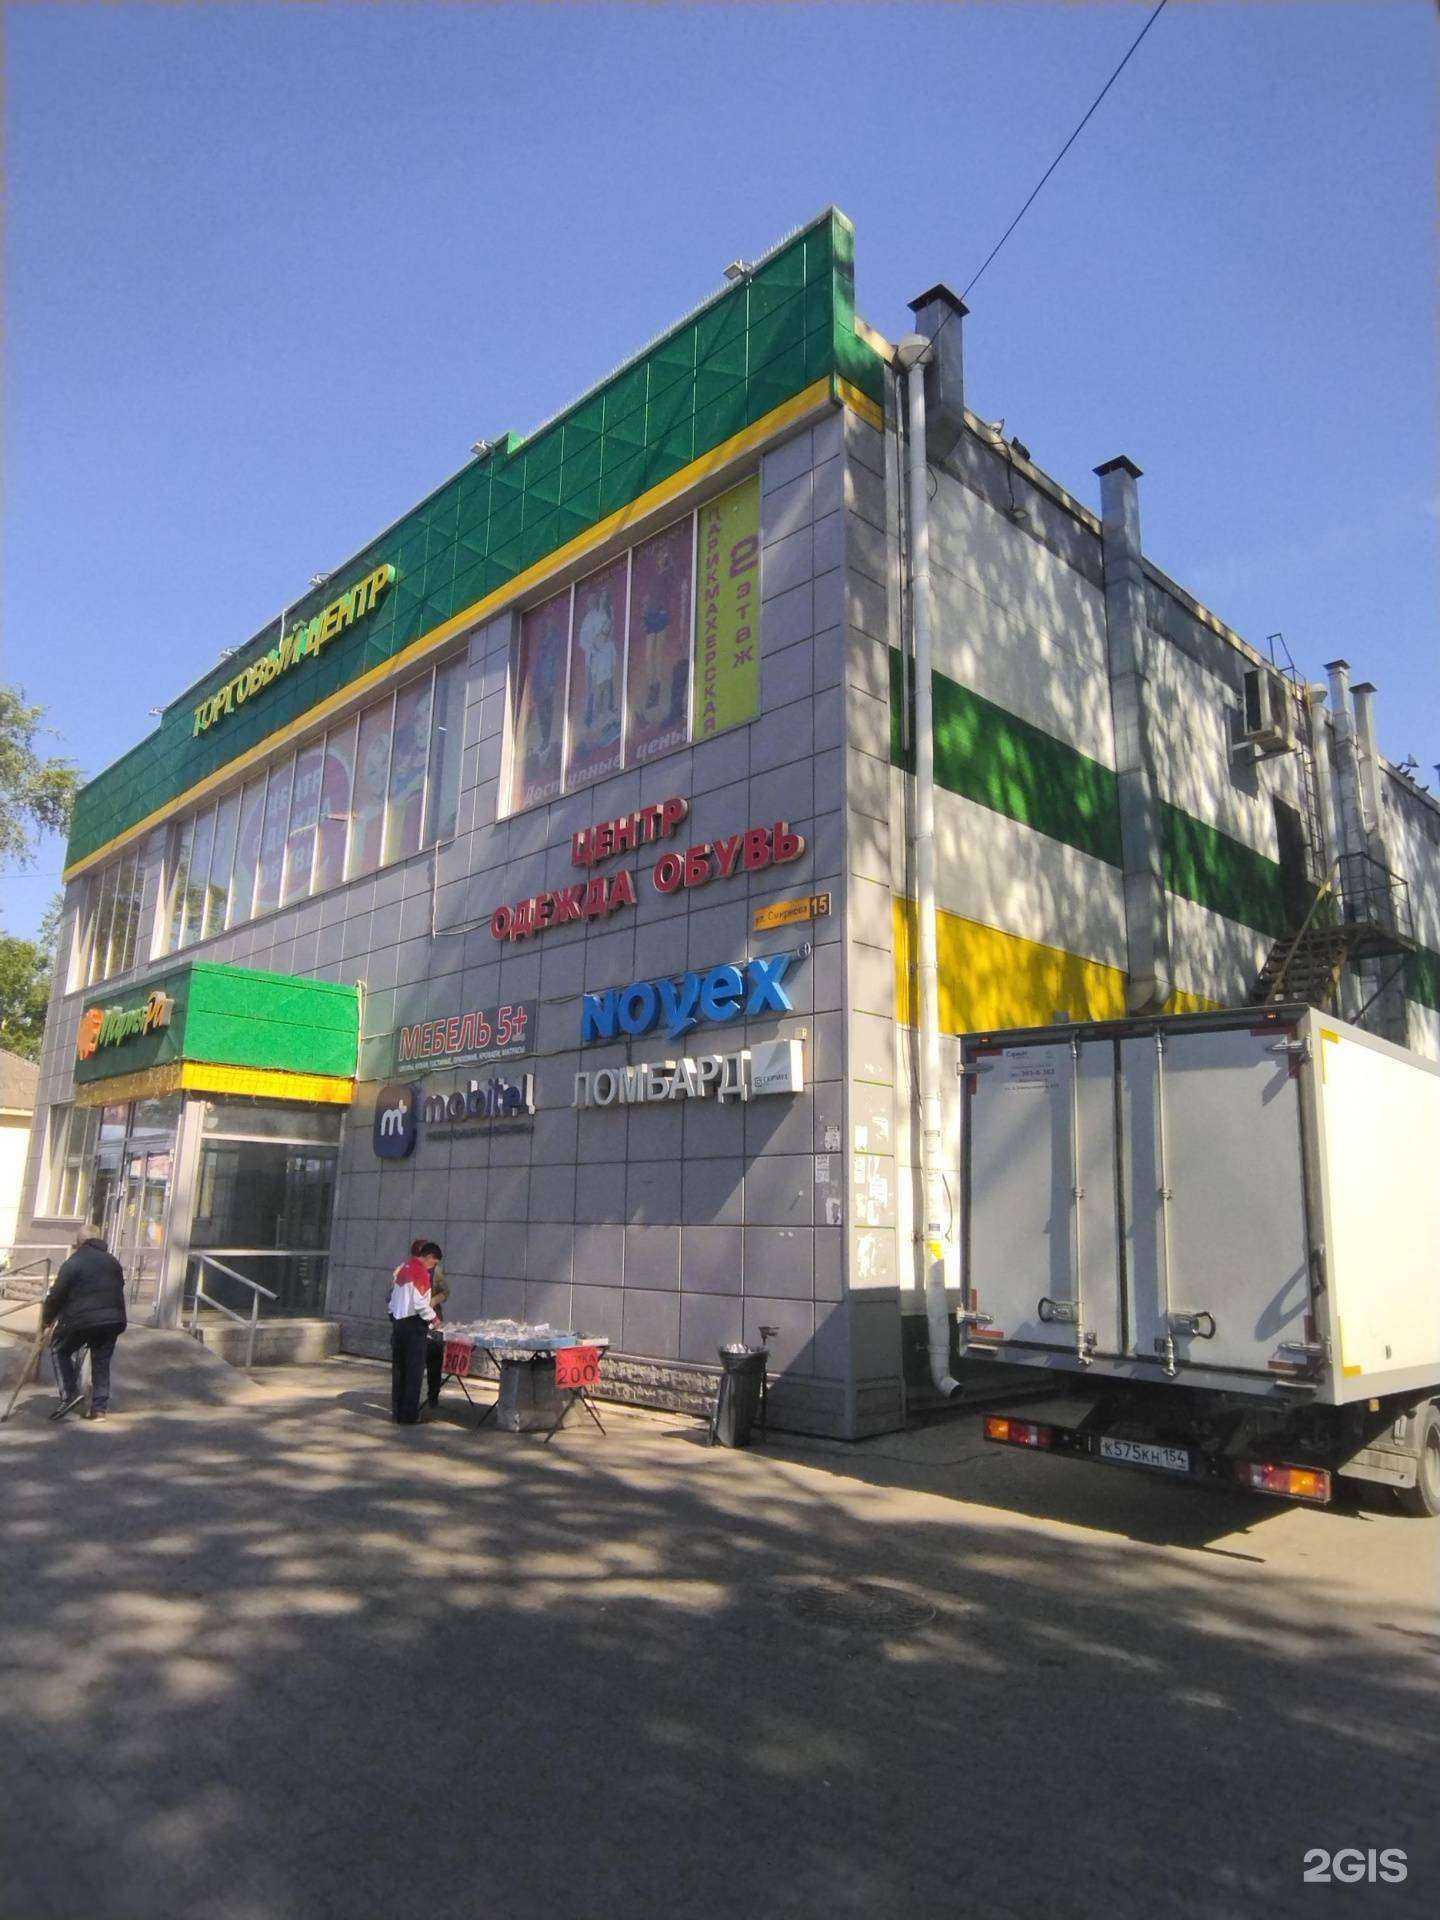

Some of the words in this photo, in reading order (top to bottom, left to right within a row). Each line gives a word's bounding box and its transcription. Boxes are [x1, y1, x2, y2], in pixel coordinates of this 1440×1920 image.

[704, 506, 721, 733] ПАРИКМАХЕРСКАЯ
[193, 620, 308, 738] ТОРГОВЫЙ
[306, 563, 396, 656] ЦЕНТР
[571, 798, 689, 868] ЦЕНТР
[490, 869, 638, 942] ОДЕЖДА
[653, 820, 806, 894] ОБУВЬ
[810, 896, 828, 916] 15
[399, 1011, 491, 1061] МЕБЕЛЬ
[497, 1005, 528, 1045] 5+
[572, 1048, 752, 1109] ЛОМБАРД
[557, 1364, 596, 1385] 200
[1163, 1448, 1185, 1463] 154
